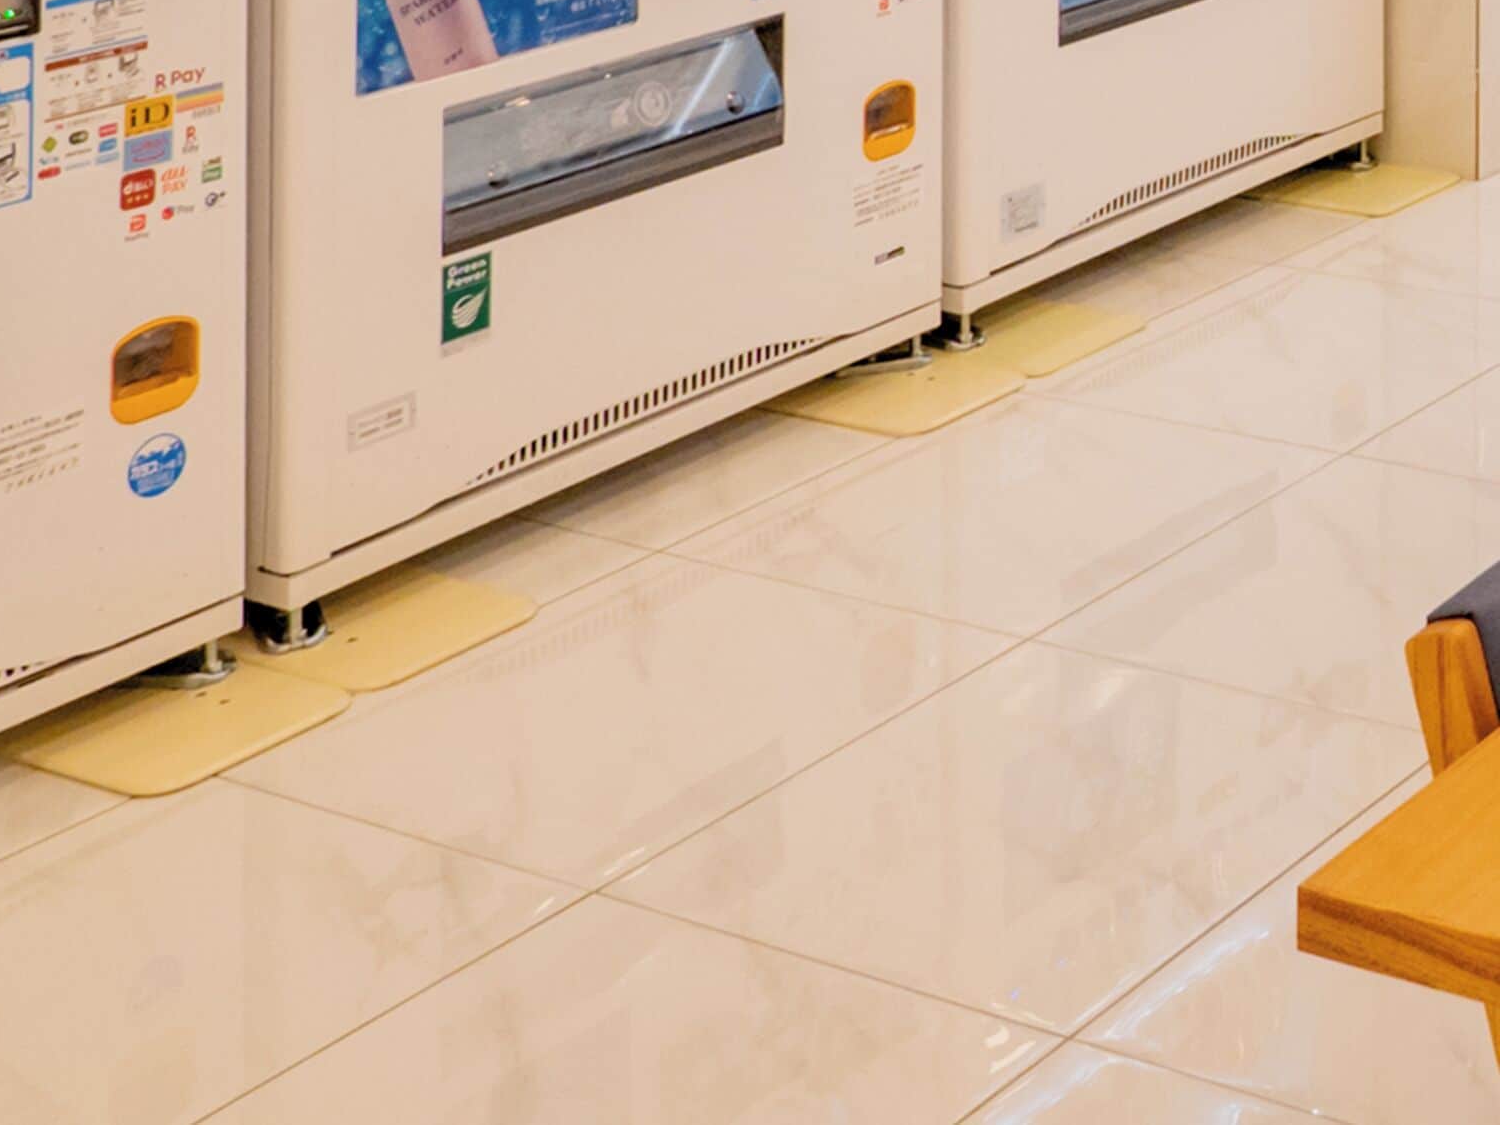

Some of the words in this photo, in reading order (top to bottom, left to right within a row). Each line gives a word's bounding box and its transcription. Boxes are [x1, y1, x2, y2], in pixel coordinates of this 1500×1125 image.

[170, 67, 207, 85] Pay
[130, 101, 171, 128] iD
[444, 265, 490, 291] Power
[445, 258, 488, 279] Green
